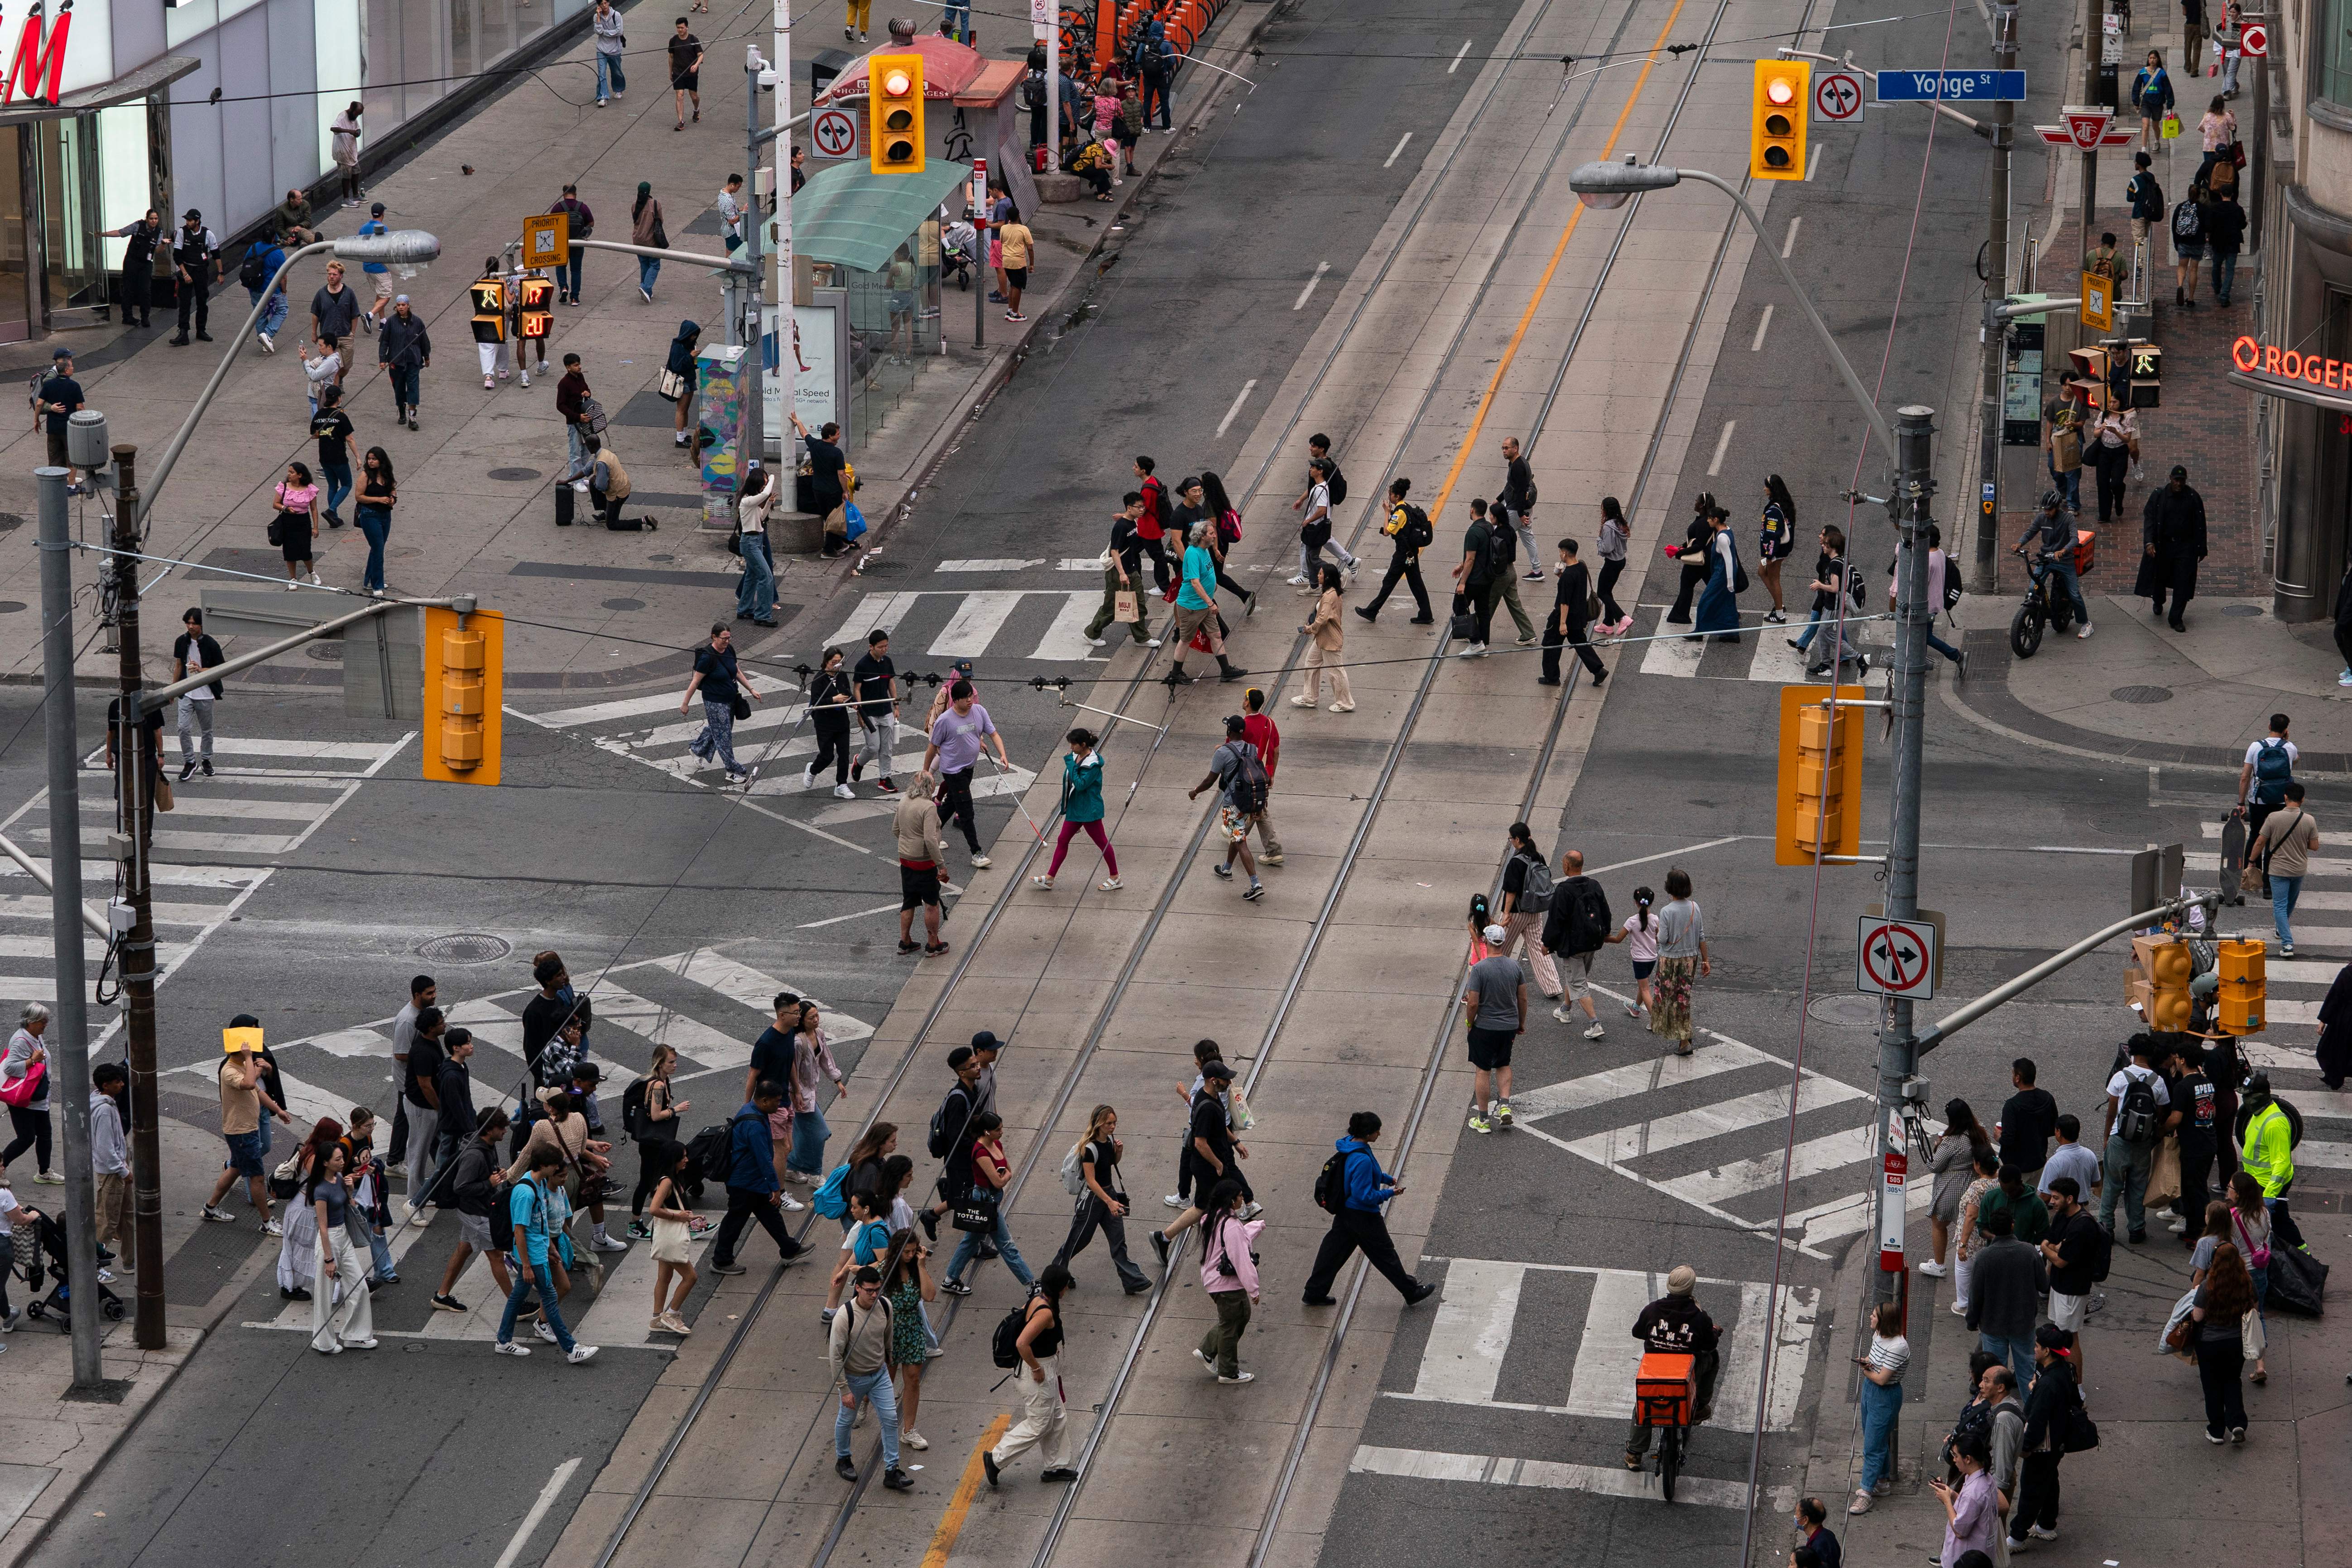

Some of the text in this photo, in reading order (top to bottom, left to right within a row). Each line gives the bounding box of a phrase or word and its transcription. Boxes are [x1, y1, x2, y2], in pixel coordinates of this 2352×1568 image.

[1912, 74, 1991, 98] Yonge St
[532, 218, 559, 228] PRIORITY
[530, 254, 561, 265] CROSSING
[2087, 276, 2107, 290] PRIORITY
[2086, 313, 2107, 327] CROSSING
[803, 388, 830, 398] Speed
[2340, 414, 2352, 435] 3
[1165, 550, 1178, 559] BAPE
[1896, 1115, 1901, 1127] NO
[1890, 1123, 1905, 1143] STANDING
